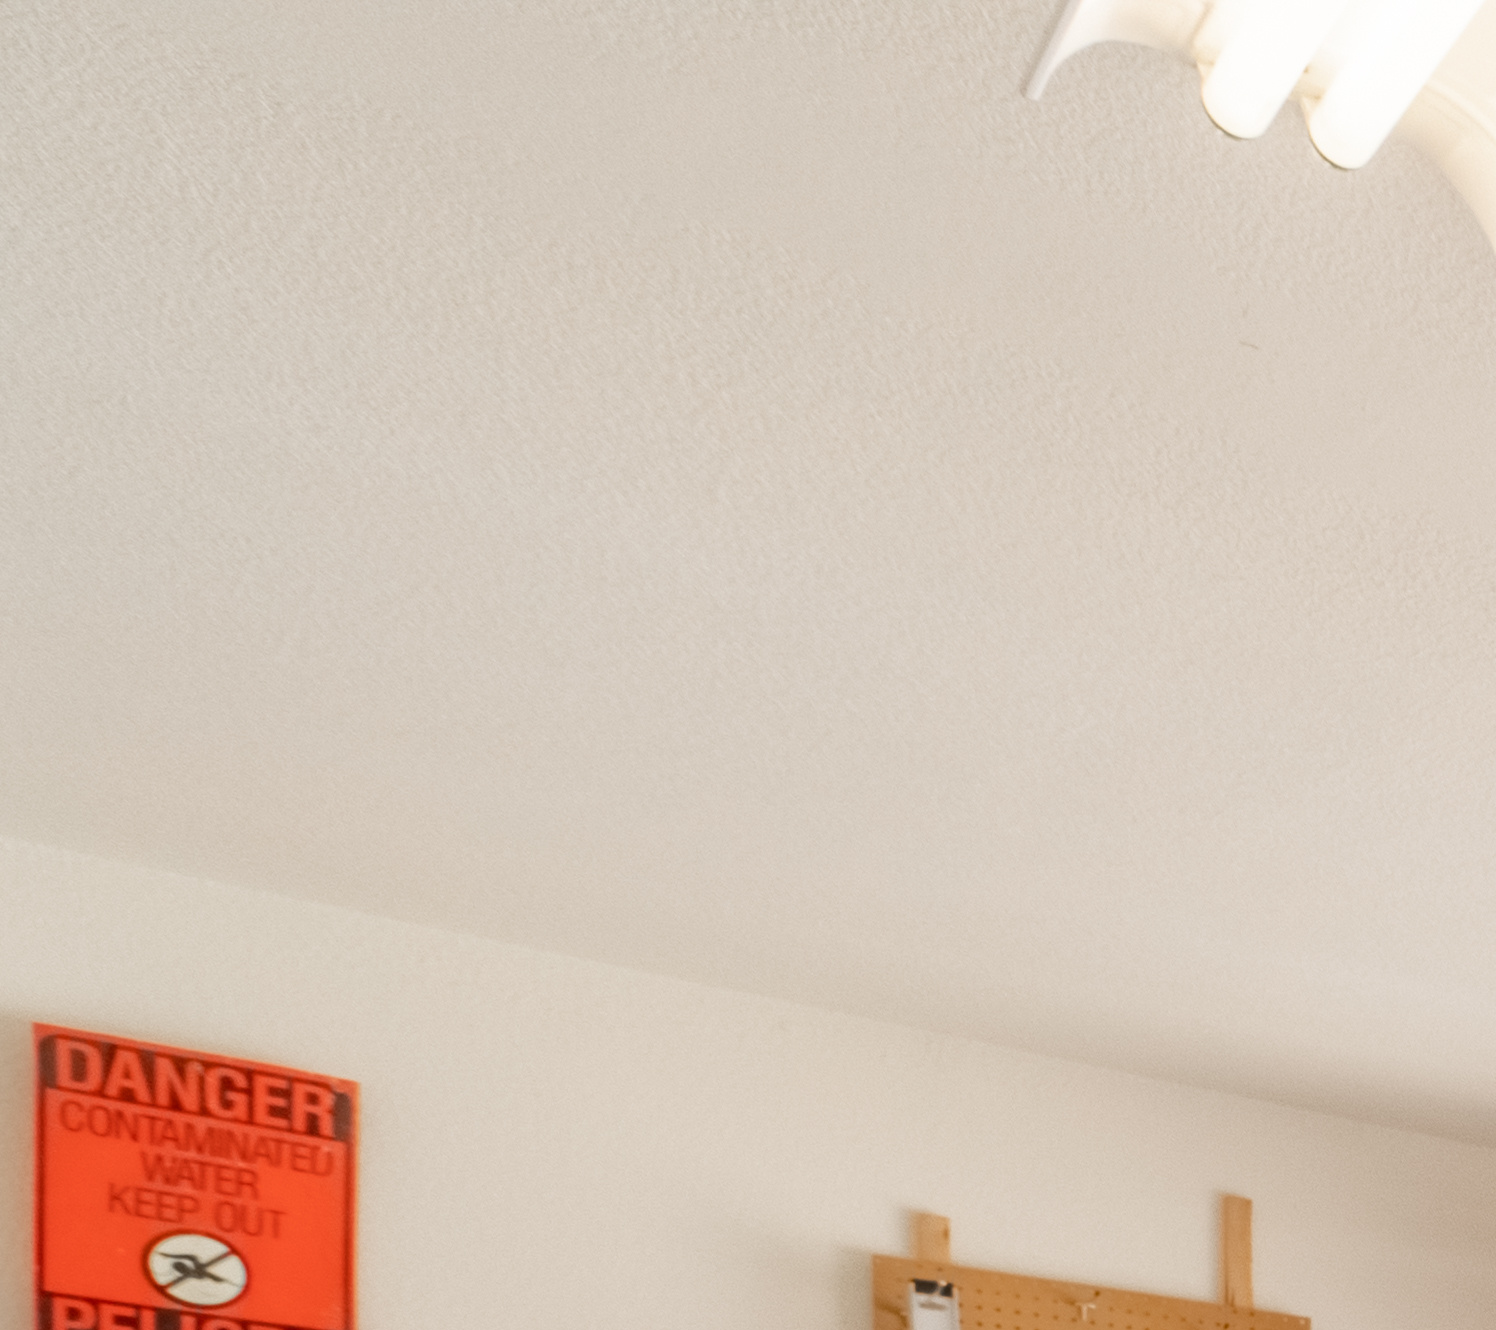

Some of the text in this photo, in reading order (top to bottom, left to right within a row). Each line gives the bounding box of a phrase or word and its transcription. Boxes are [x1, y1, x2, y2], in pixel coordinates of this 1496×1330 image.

[55, 1038, 334, 1138] DANGER
[59, 1100, 334, 1177] CONTAMINATED
[140, 1151, 259, 1200] WATER
[108, 1182, 288, 1239] KEEP OUT
